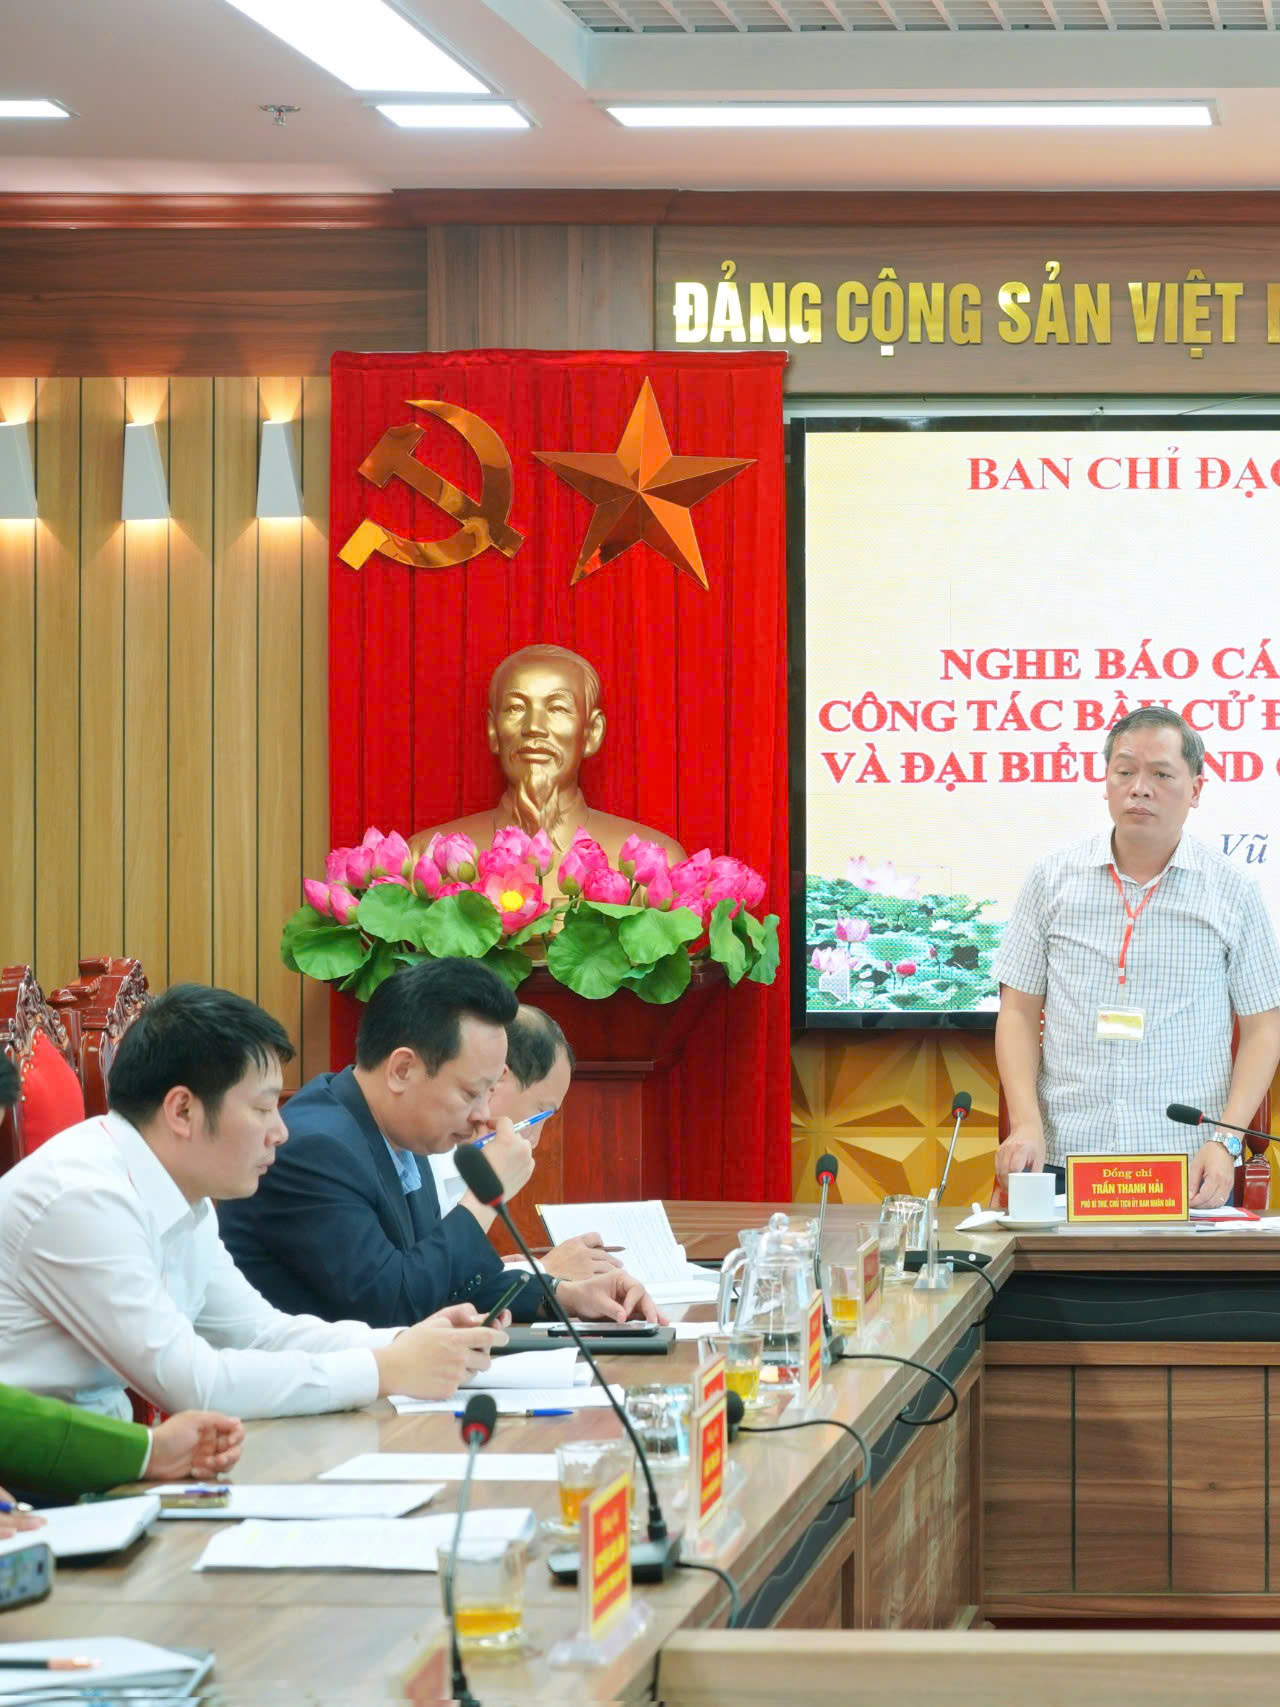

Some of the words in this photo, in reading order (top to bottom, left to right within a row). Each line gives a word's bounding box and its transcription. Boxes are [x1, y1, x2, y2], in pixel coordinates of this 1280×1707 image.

[673, 260, 822, 344] ĐẢNG
[835, 267, 983, 357] CỘNG
[998, 261, 1111, 344] SẢN
[1128, 269, 1244, 359] VIỆT
[967, 457, 1073, 490] BAN
[1087, 446, 1182, 490] CHỈ
[940, 648, 1081, 681] NGHE
[1095, 638, 1199, 680] BÁO
[818, 690, 957, 733] CÔNG
[967, 690, 1063, 732] TÁC
[1073, 690, 1173, 732] BẦ
[1181, 690, 1256, 732] CỬ
[820, 742, 892, 784] VÀ
[901, 751, 987, 792] ĐẠI
[999, 741, 1108, 784] BIỂU
[1221, 833, 1269, 865] Vũ
[1117, 1182, 1147, 1194] THANH
[1148, 1179, 1164, 1194] HẢI
[1135, 1168, 1153, 1178] chí
